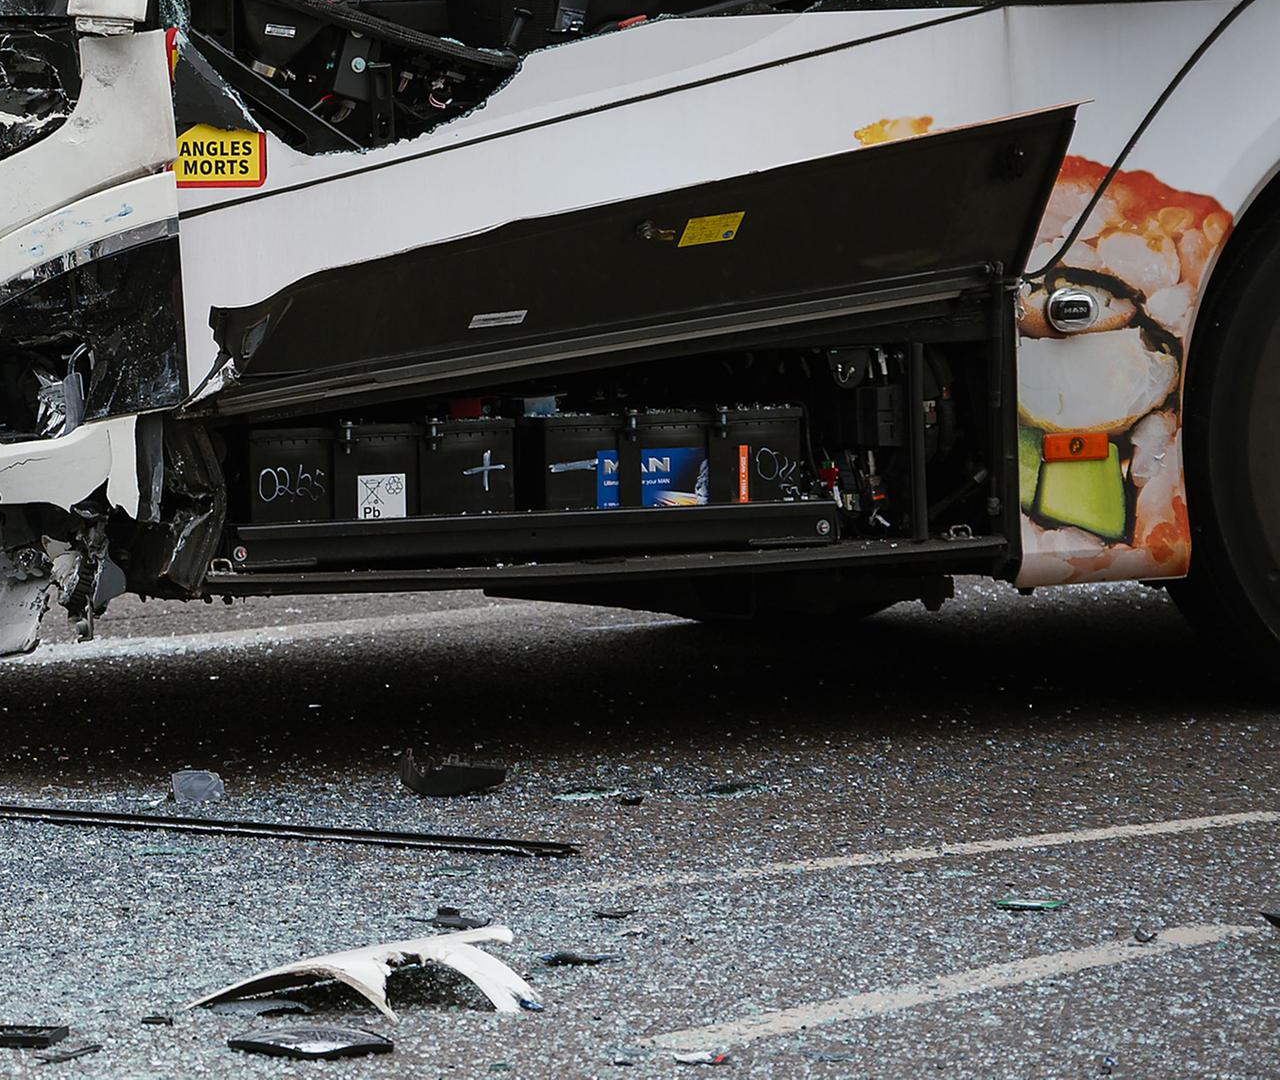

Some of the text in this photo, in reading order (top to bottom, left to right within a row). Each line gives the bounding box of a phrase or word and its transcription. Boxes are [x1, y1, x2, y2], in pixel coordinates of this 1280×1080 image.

[179, 141, 253, 157] ANGLES
[183, 159, 249, 175] MORTS
[363, 506, 381, 519] Pb
